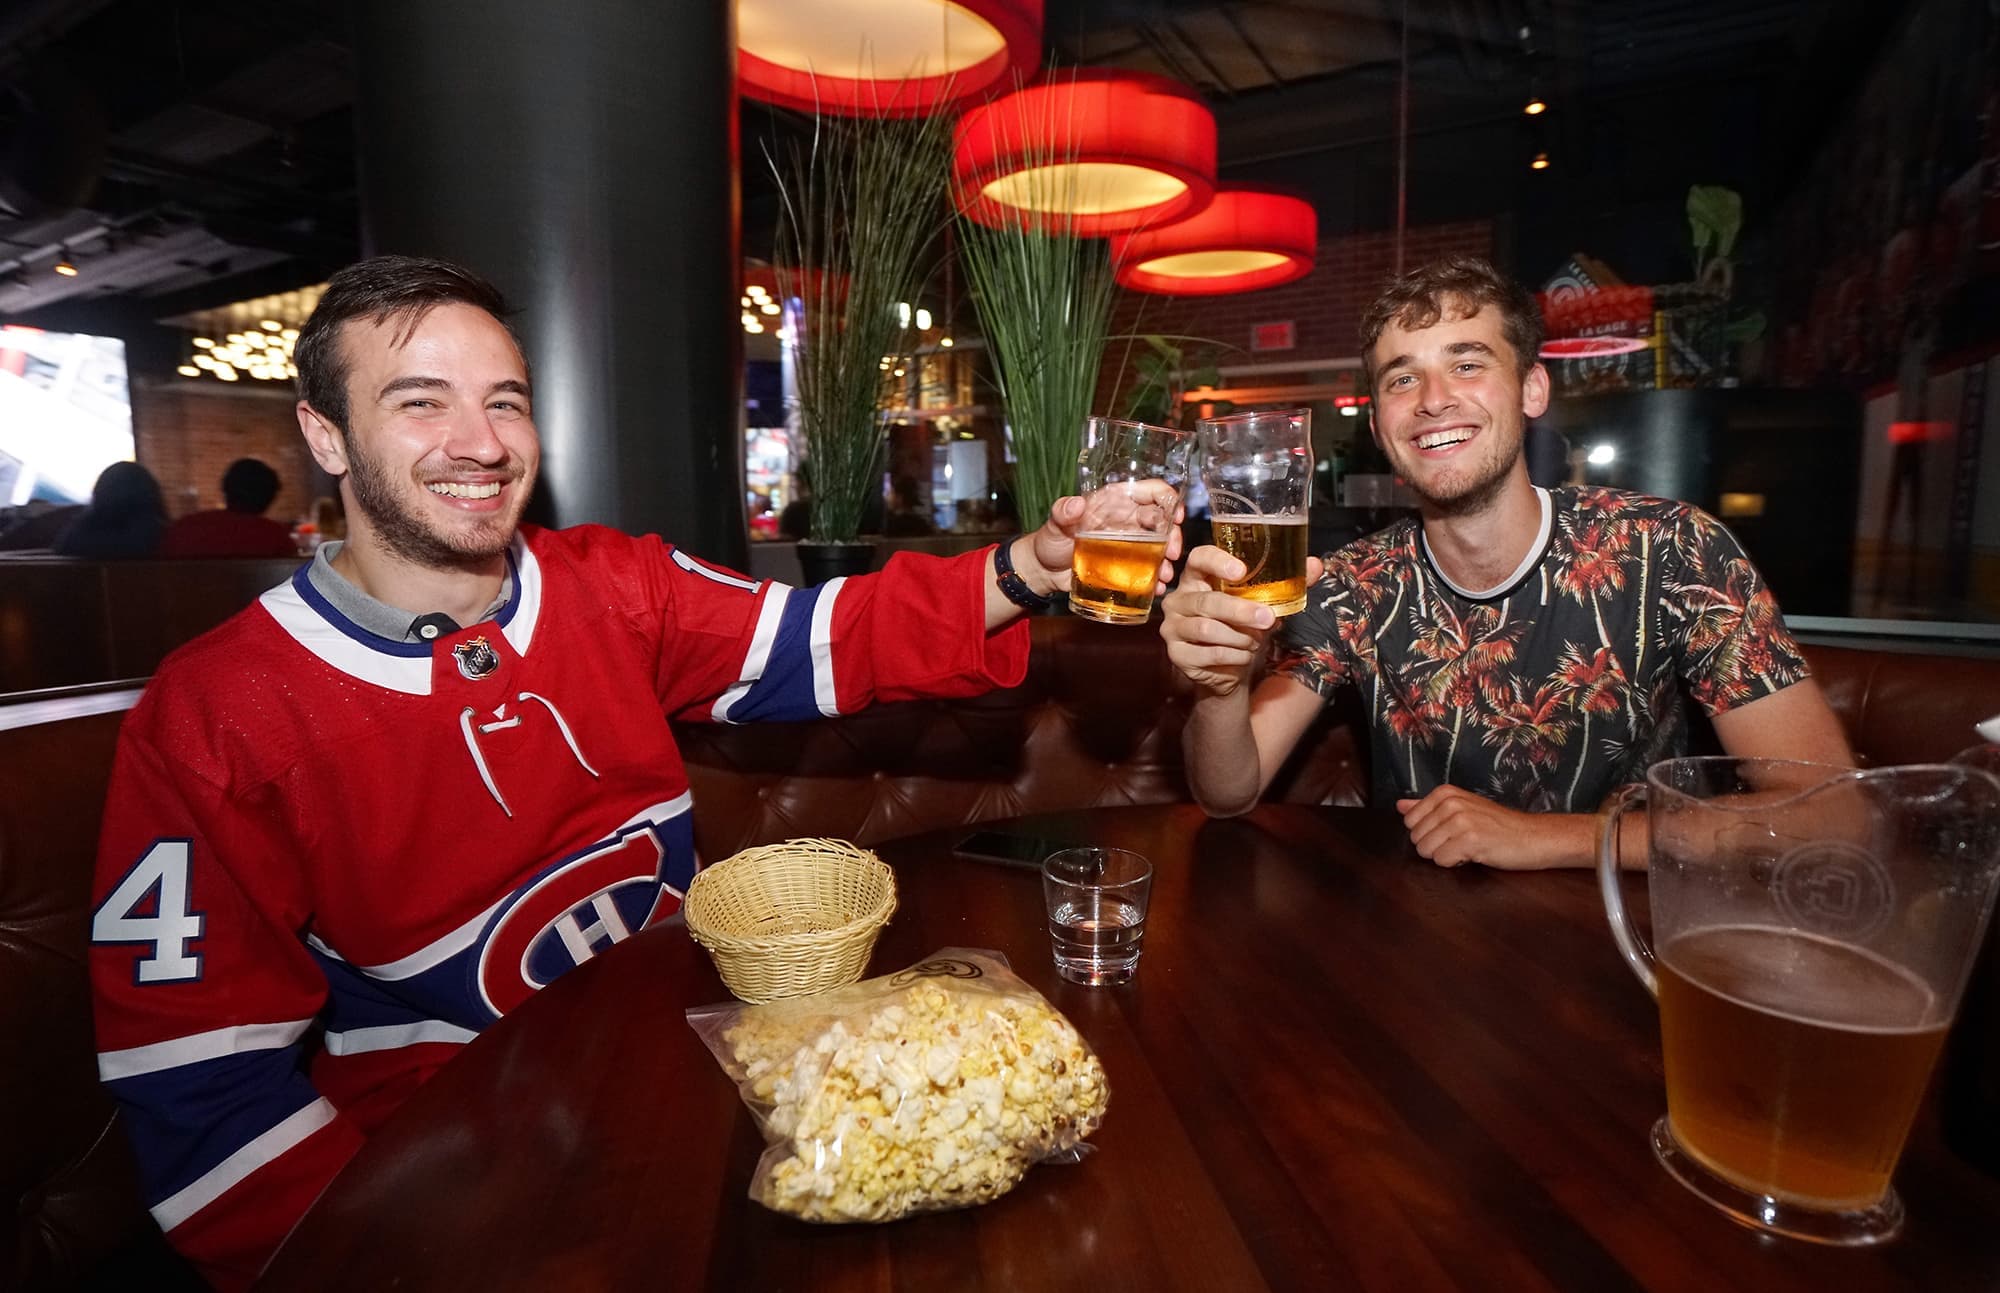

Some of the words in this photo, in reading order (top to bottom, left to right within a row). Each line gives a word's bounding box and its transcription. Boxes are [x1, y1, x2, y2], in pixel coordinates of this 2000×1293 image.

[1579, 326, 1594, 338] LA
[1596, 320, 1628, 335] CAGE
[91, 840, 202, 984] 4
